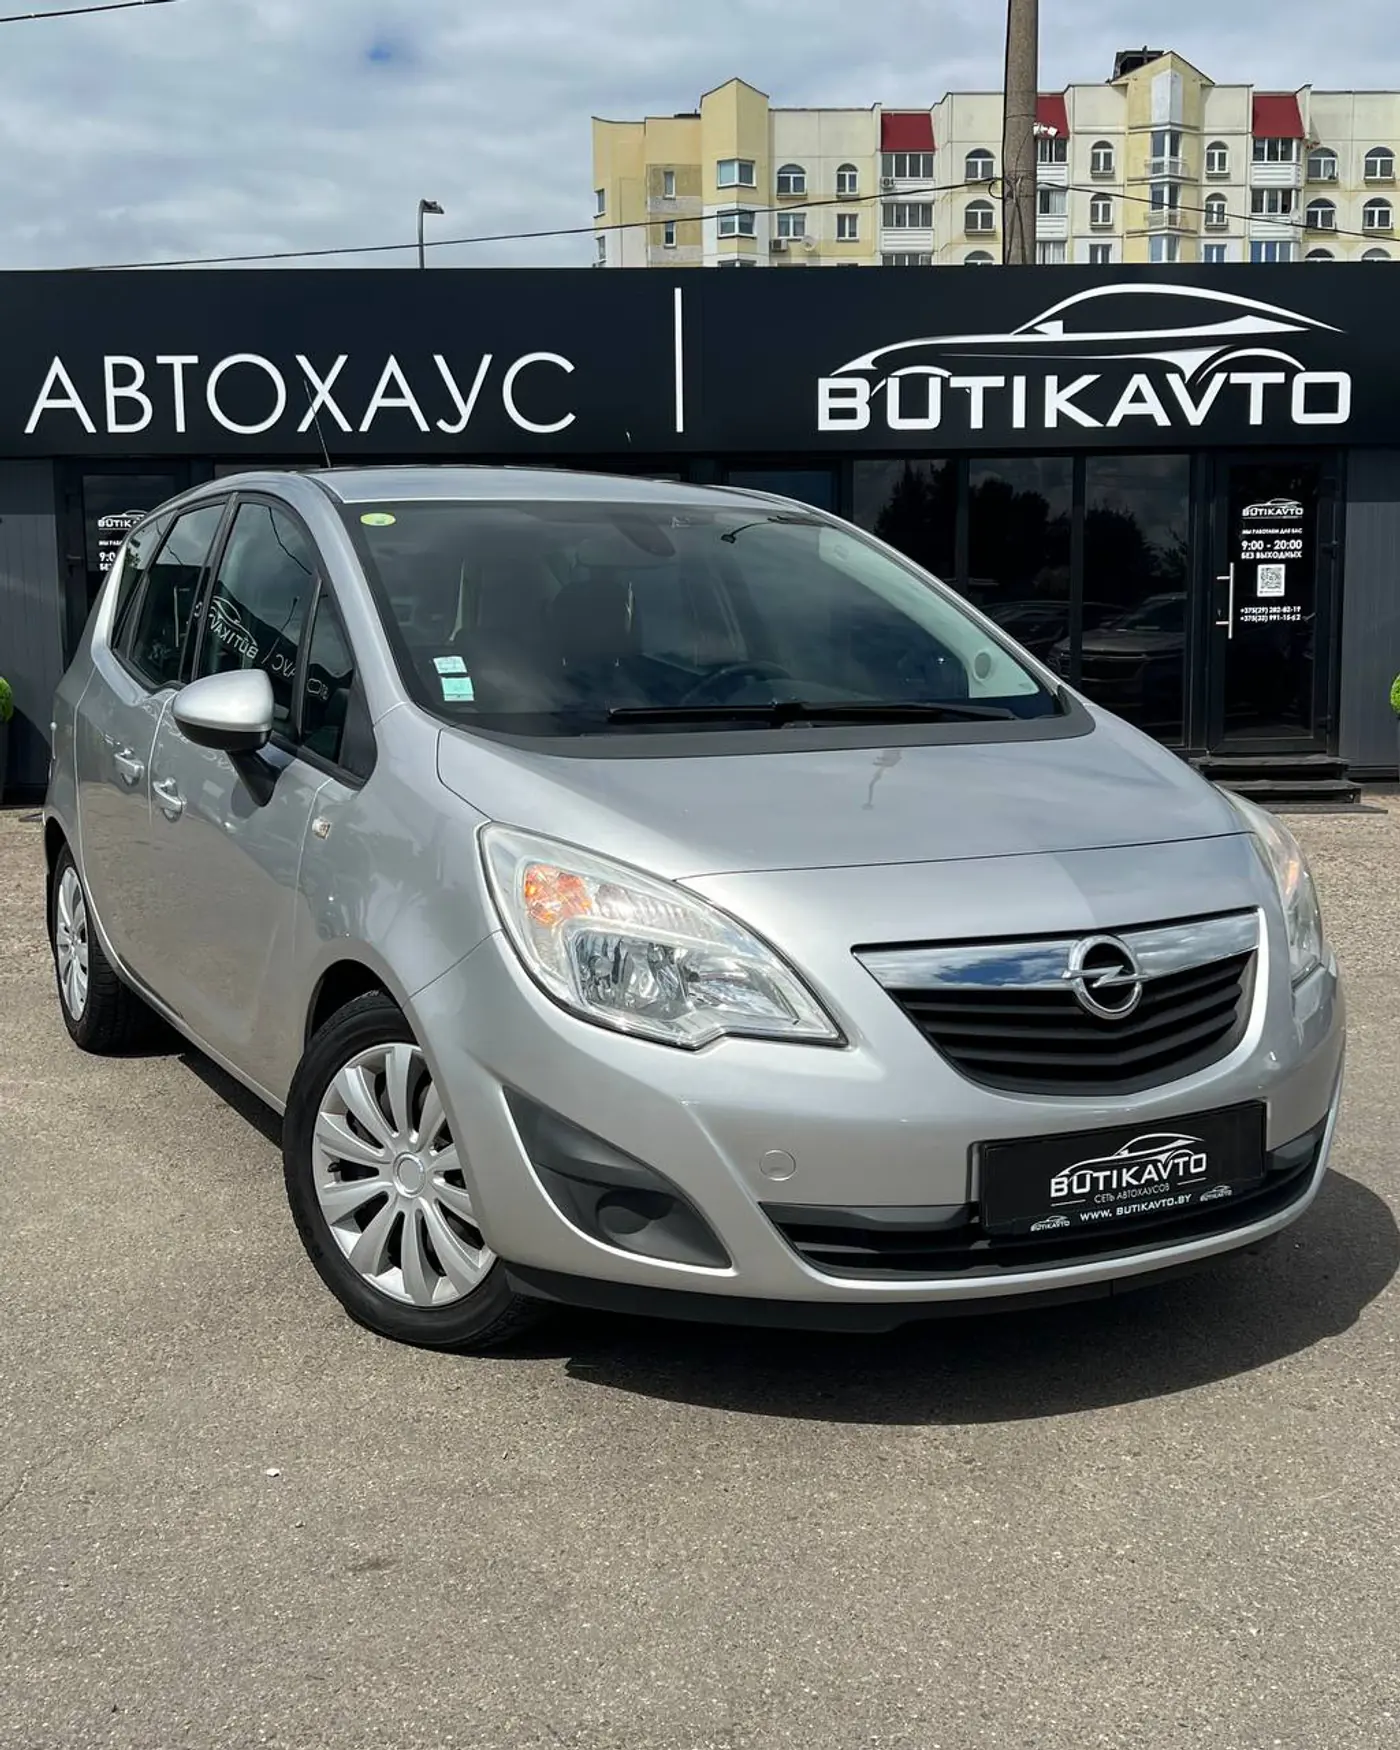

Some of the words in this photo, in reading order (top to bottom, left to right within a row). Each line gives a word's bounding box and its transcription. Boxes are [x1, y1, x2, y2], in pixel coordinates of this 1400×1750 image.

[24, 352, 577, 435] АВТОХАУС
[817, 370, 1352, 431] BUTIKAVTO
[1242, 507, 1303, 516] BUTIKAVTO
[1241, 540, 1264, 550] 9:00
[1273, 539, 1303, 550] 20:00
[1256, 551, 1303, 559] ВЫХОДНЫХ
[99, 552, 116, 561] 9:0
[1050, 1153, 1206, 1197] BUTIKAVTO
[1093, 1193, 1116, 1204] СЕТЬ
[1116, 1182, 1170, 1199] АВТОХАУСОВ
[1080, 1208, 1112, 1221] WWW.
[1115, 1193, 1193, 1216] BUTIKAVTO.BY
